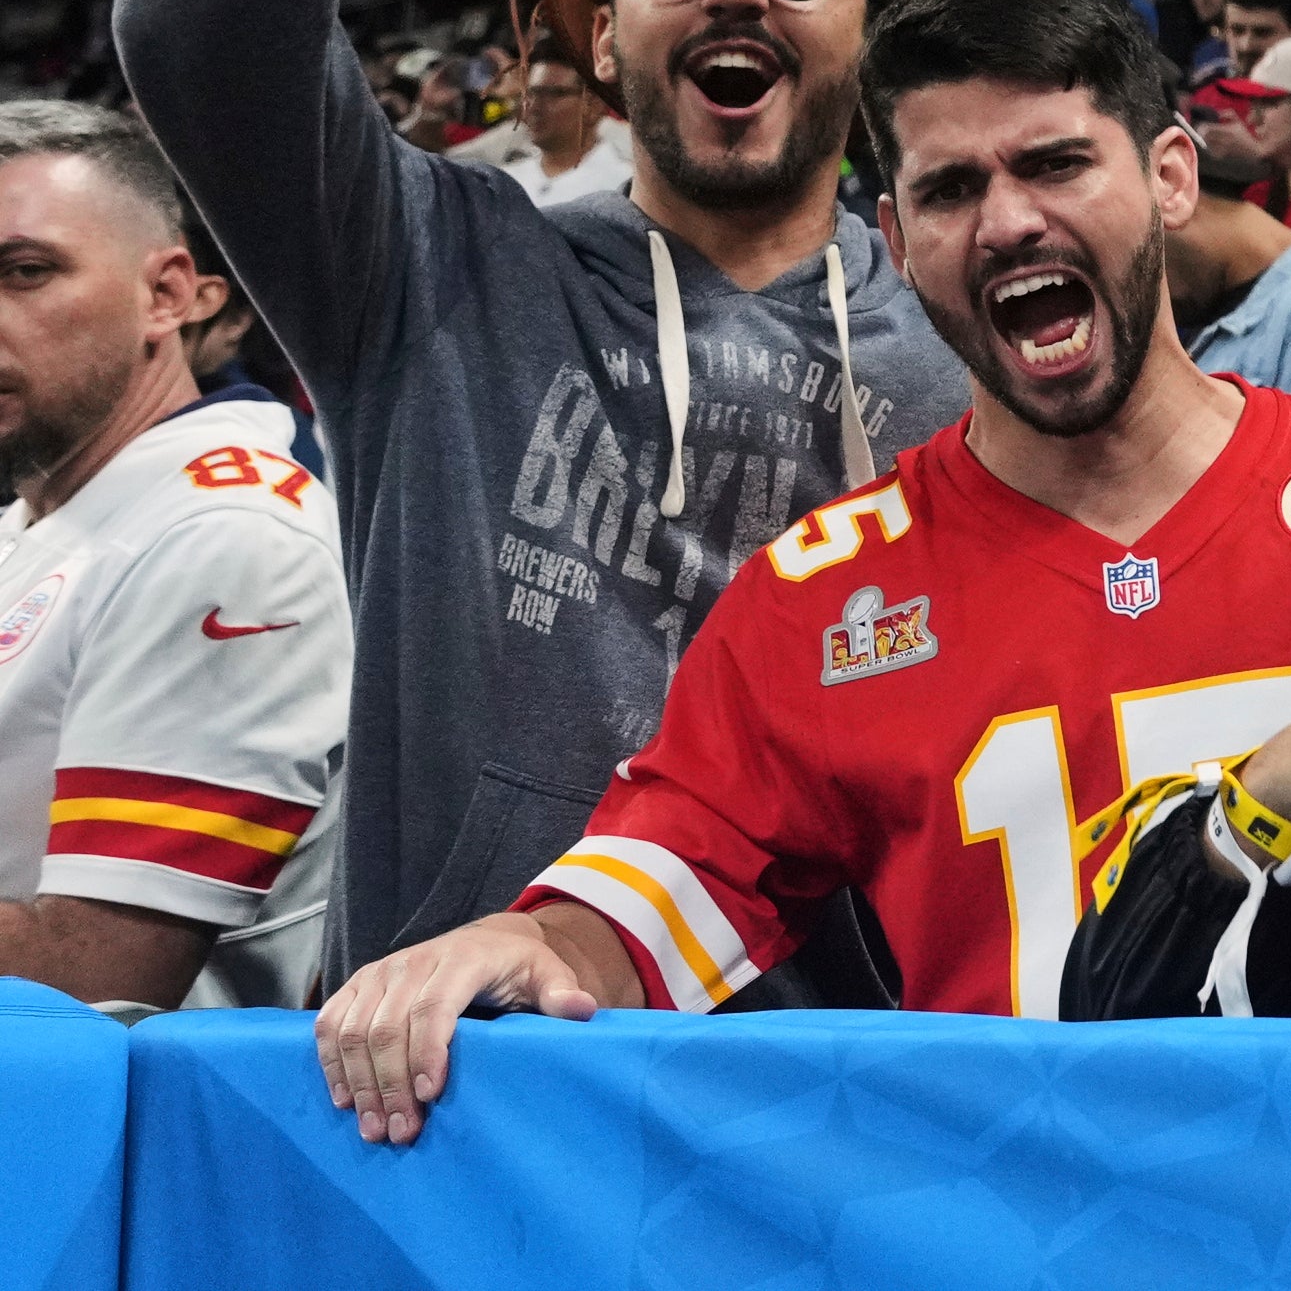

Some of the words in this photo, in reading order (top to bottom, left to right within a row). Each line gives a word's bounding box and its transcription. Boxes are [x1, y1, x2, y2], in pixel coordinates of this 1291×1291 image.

[600, 340, 894, 439] WIIAMSBURG
[182, 446, 313, 510] 87
[499, 533, 601, 605] BREWERS
[1112, 580, 1152, 607] NFL
[507, 583, 561, 636] ROW
[840, 659, 883, 674] SUPER
[887, 647, 920, 663] BOWL
